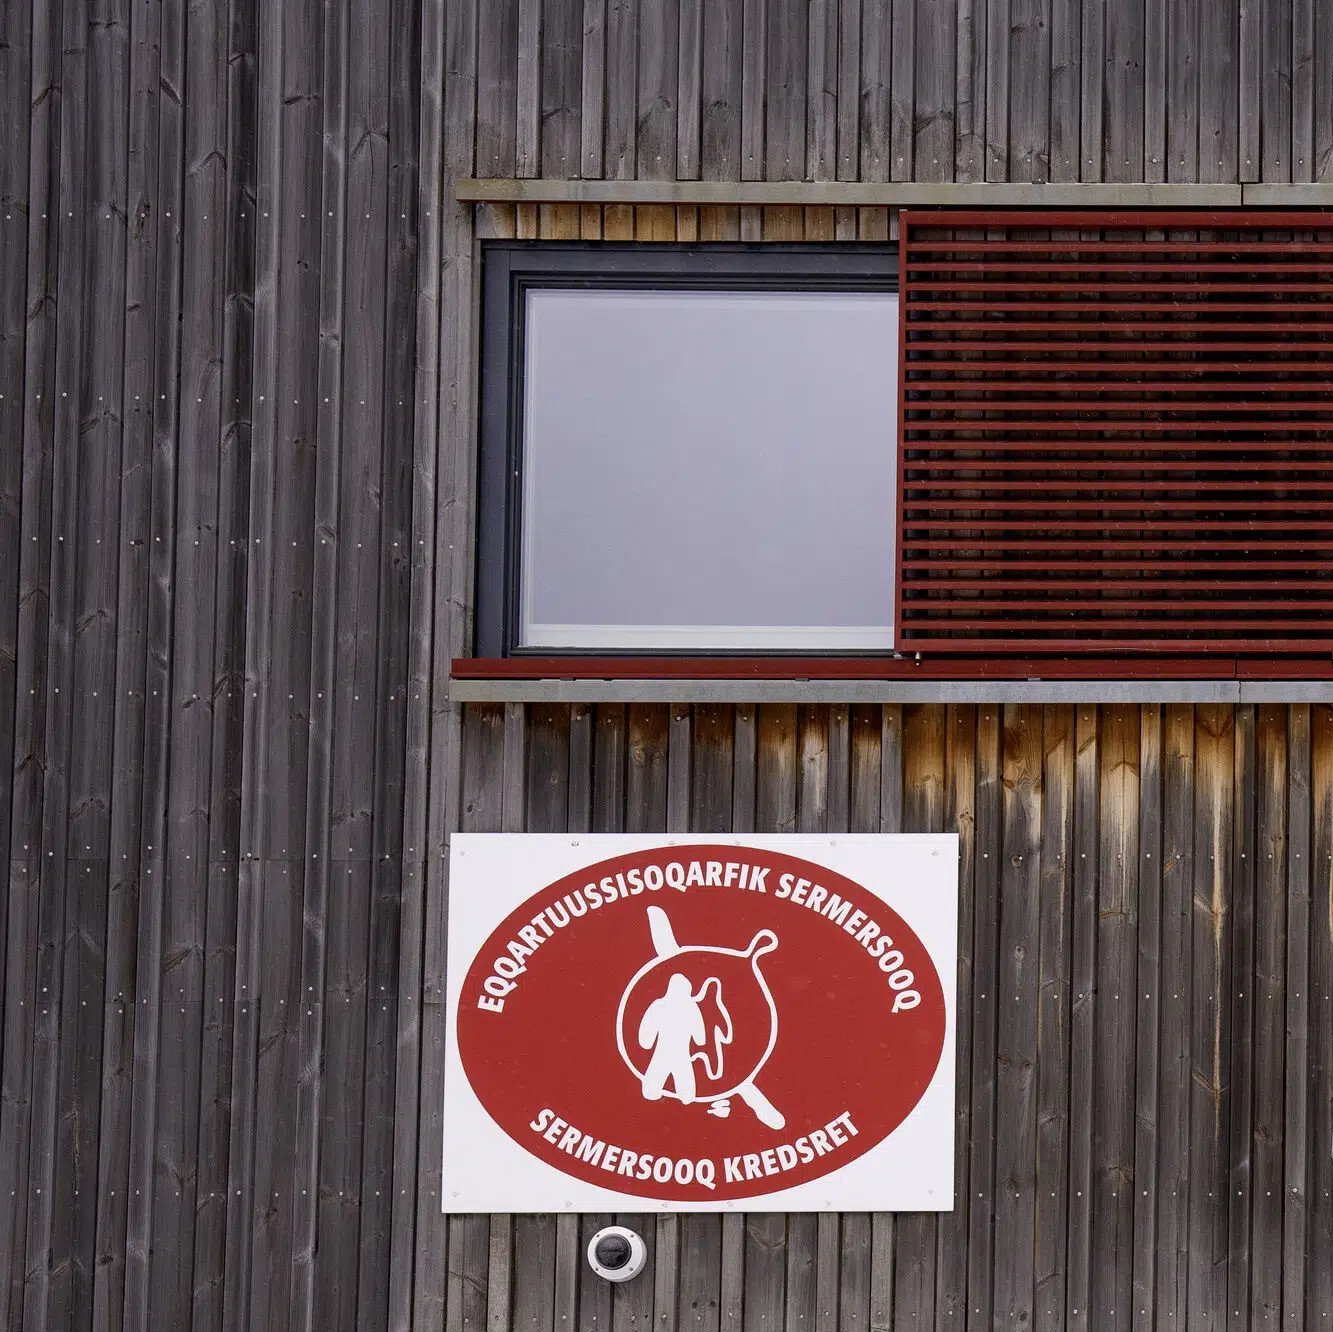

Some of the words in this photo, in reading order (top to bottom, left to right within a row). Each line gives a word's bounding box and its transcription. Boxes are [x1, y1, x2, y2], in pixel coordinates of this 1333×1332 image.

[477, 861, 772, 1014] EQQARTUUSSISOQARFIK
[774, 873, 922, 1014] SERMERSOOQ
[529, 1108, 717, 1191] SERMERSOOQ
[723, 1110, 859, 1183] KREDSRET
